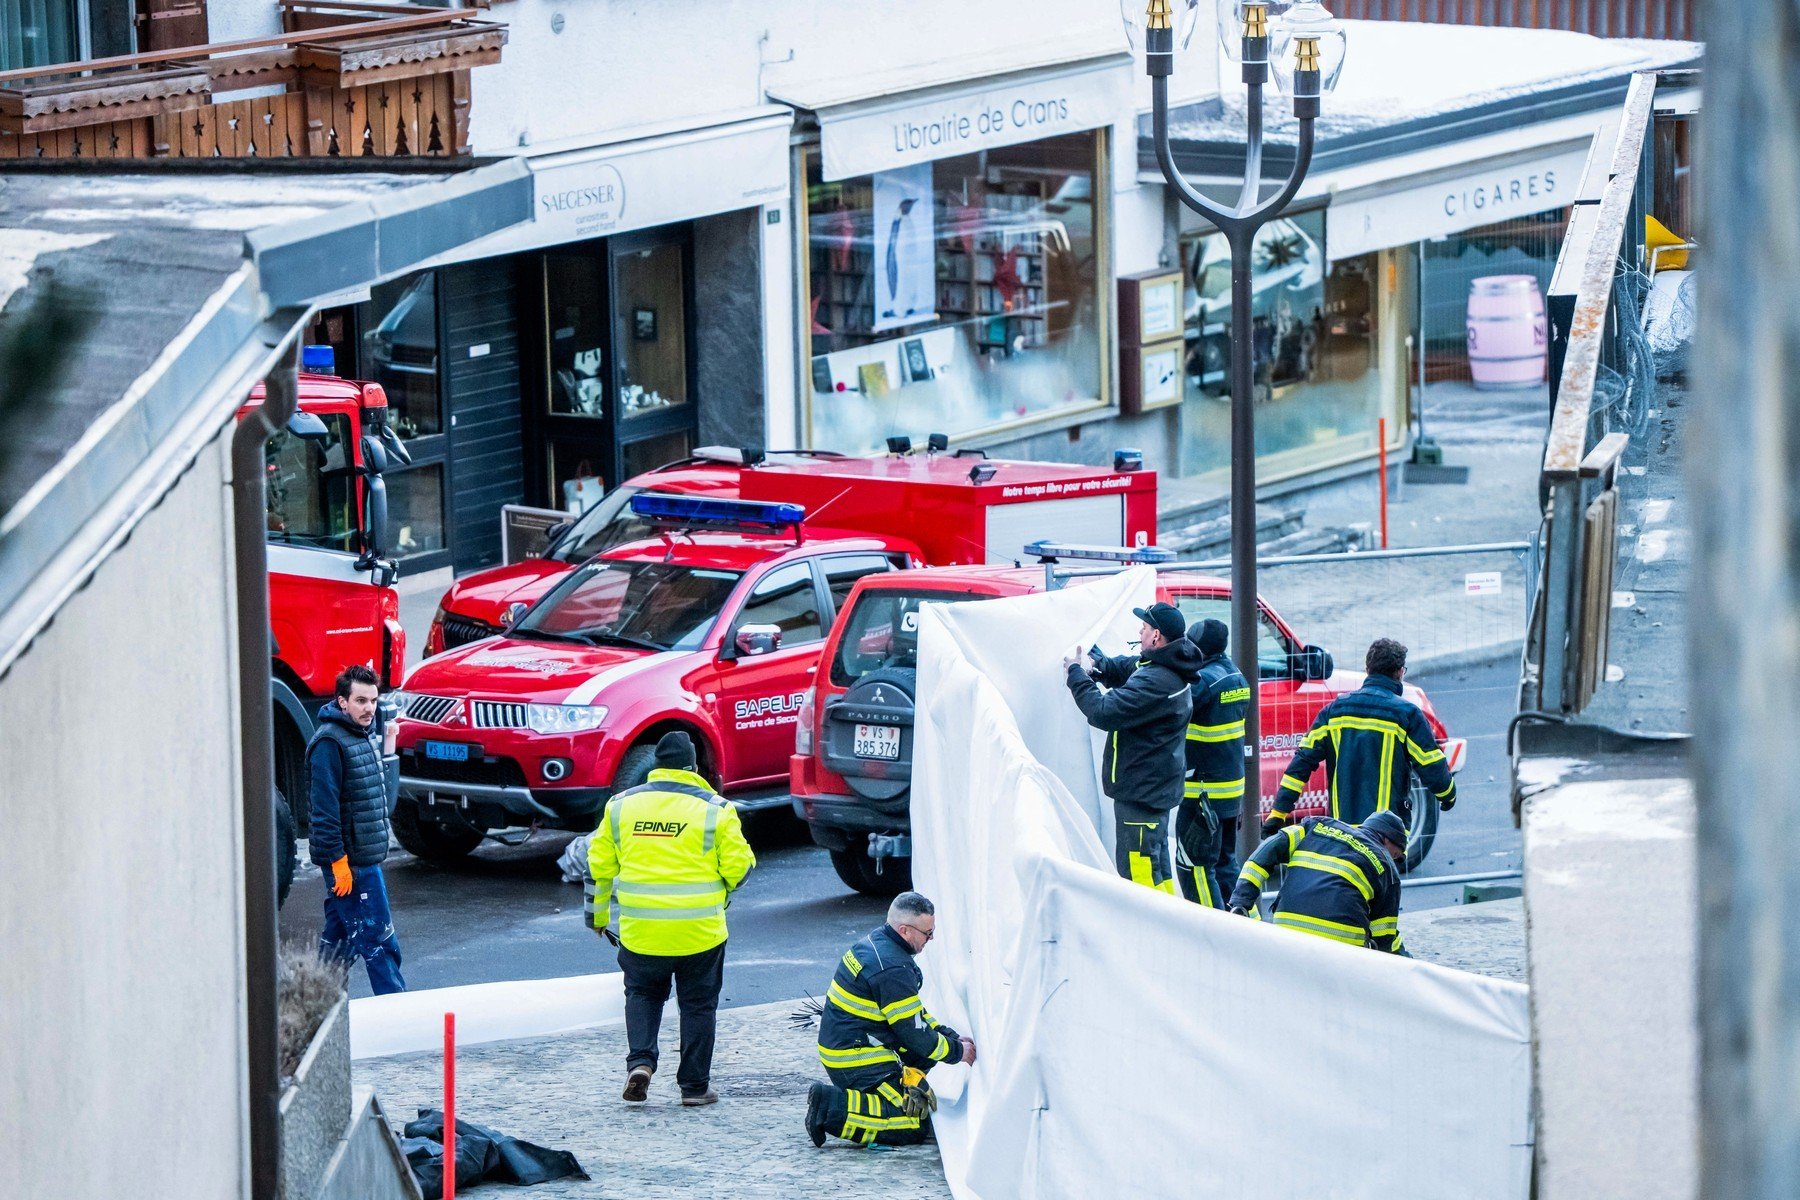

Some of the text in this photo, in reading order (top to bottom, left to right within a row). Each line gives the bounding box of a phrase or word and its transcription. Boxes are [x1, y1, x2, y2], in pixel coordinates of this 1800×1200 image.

[894, 97, 1068, 152] Librairie de Crans
[541, 184, 615, 212] SAEGESSER
[1444, 171, 1556, 217] CIGARES
[1003, 475, 1132, 497] Notre temps libre pour votre sécurité!
[735, 719, 763, 730] Centre
[764, 716, 775, 726] de
[848, 711, 900, 722] PAJERO
[872, 727, 883, 739] VS
[428, 743, 438, 755] VS
[633, 821, 688, 838] EPINEY
